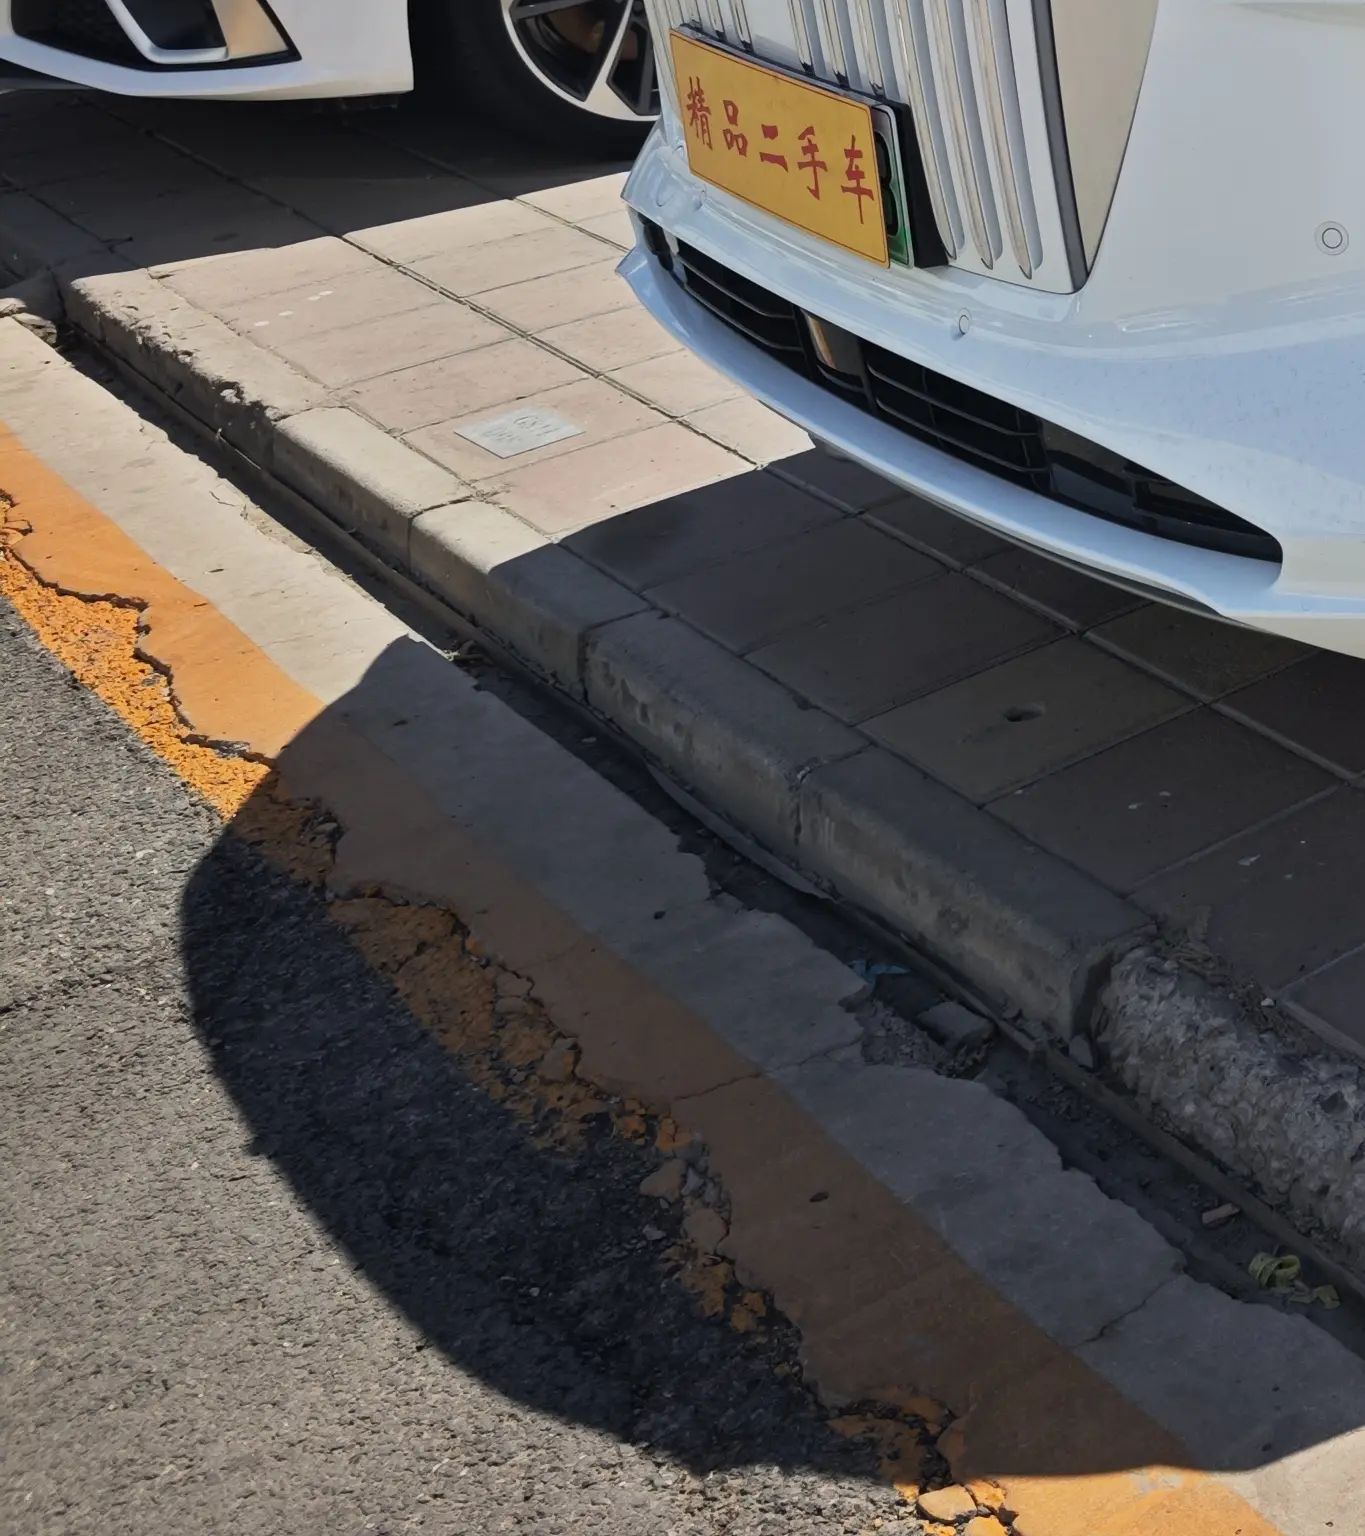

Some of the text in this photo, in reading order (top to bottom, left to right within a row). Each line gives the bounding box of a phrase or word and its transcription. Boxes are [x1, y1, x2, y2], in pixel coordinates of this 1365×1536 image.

[685, 76, 874, 225] 精品二手车
